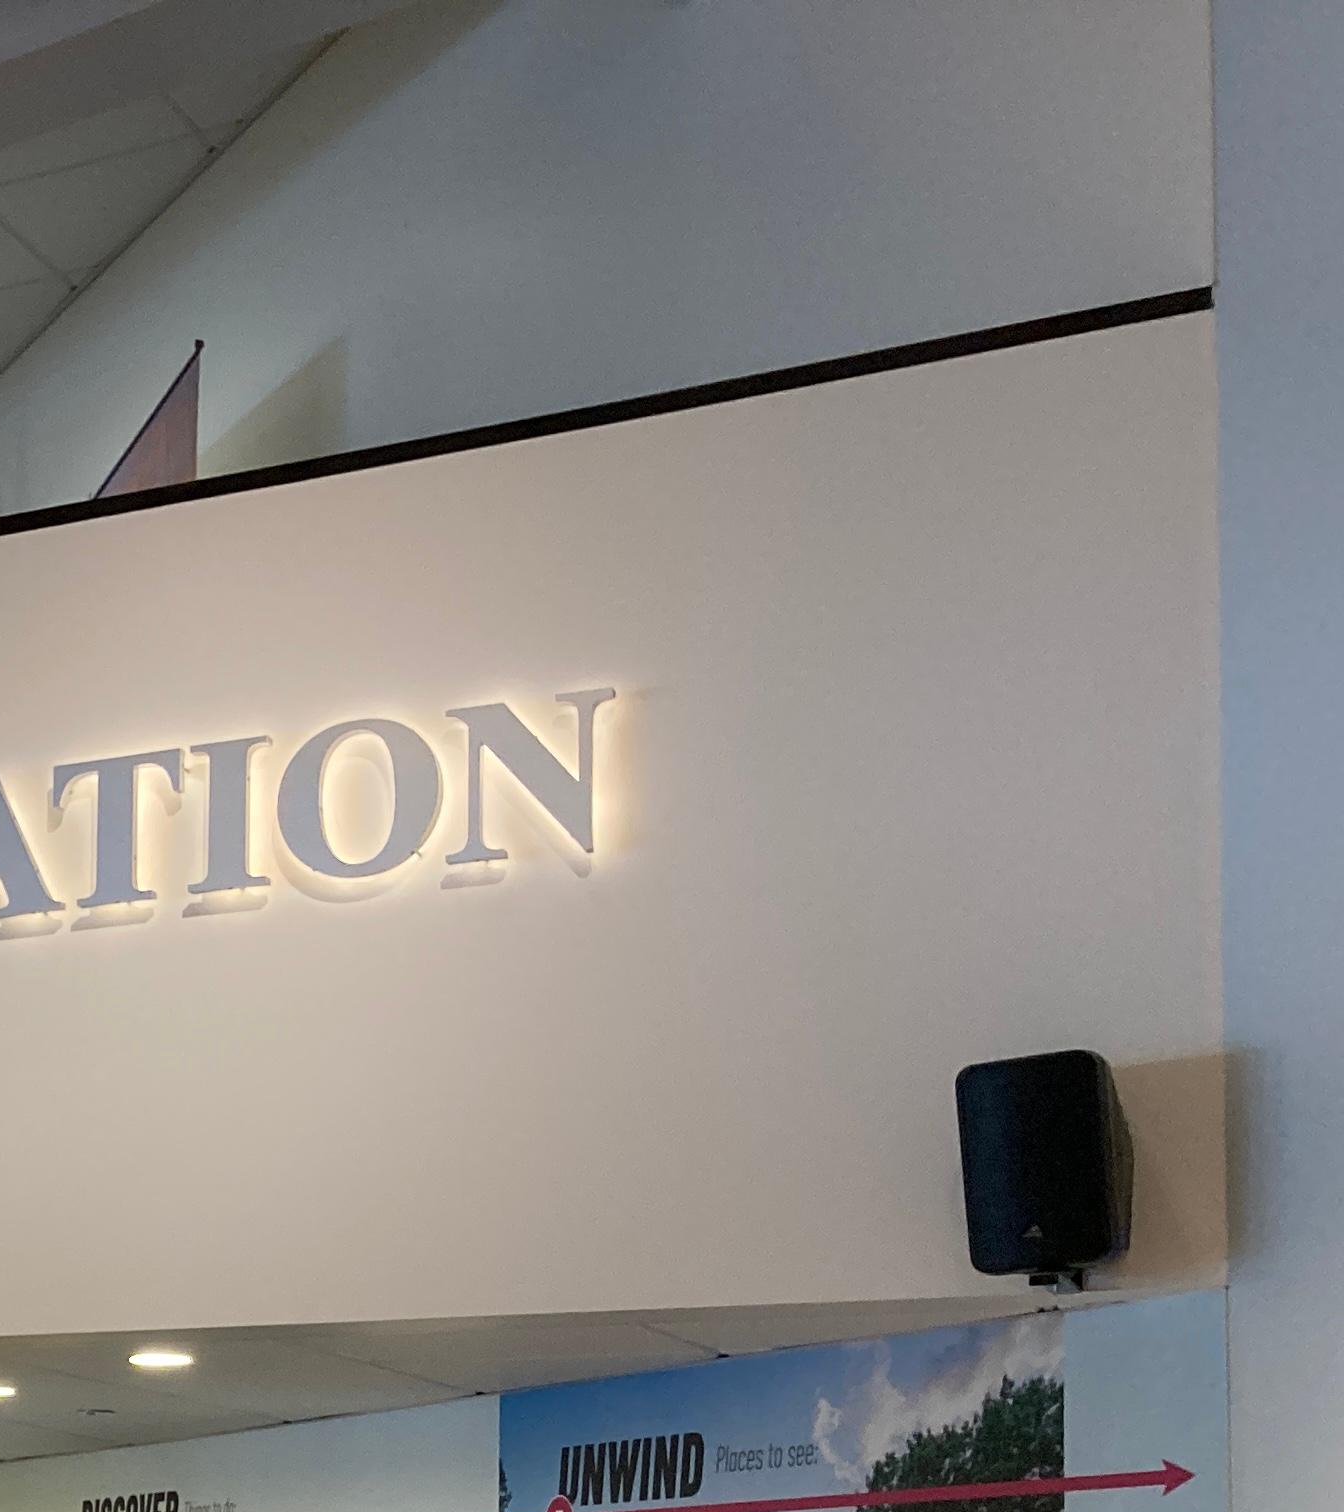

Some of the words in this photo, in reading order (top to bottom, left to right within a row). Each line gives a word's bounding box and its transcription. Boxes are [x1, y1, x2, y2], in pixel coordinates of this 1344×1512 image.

[558, 1432, 704, 1508] UNWIND
[715, 1443, 764, 1474] Places
[768, 1445, 783, 1469] to
[787, 1444, 819, 1466] see:
